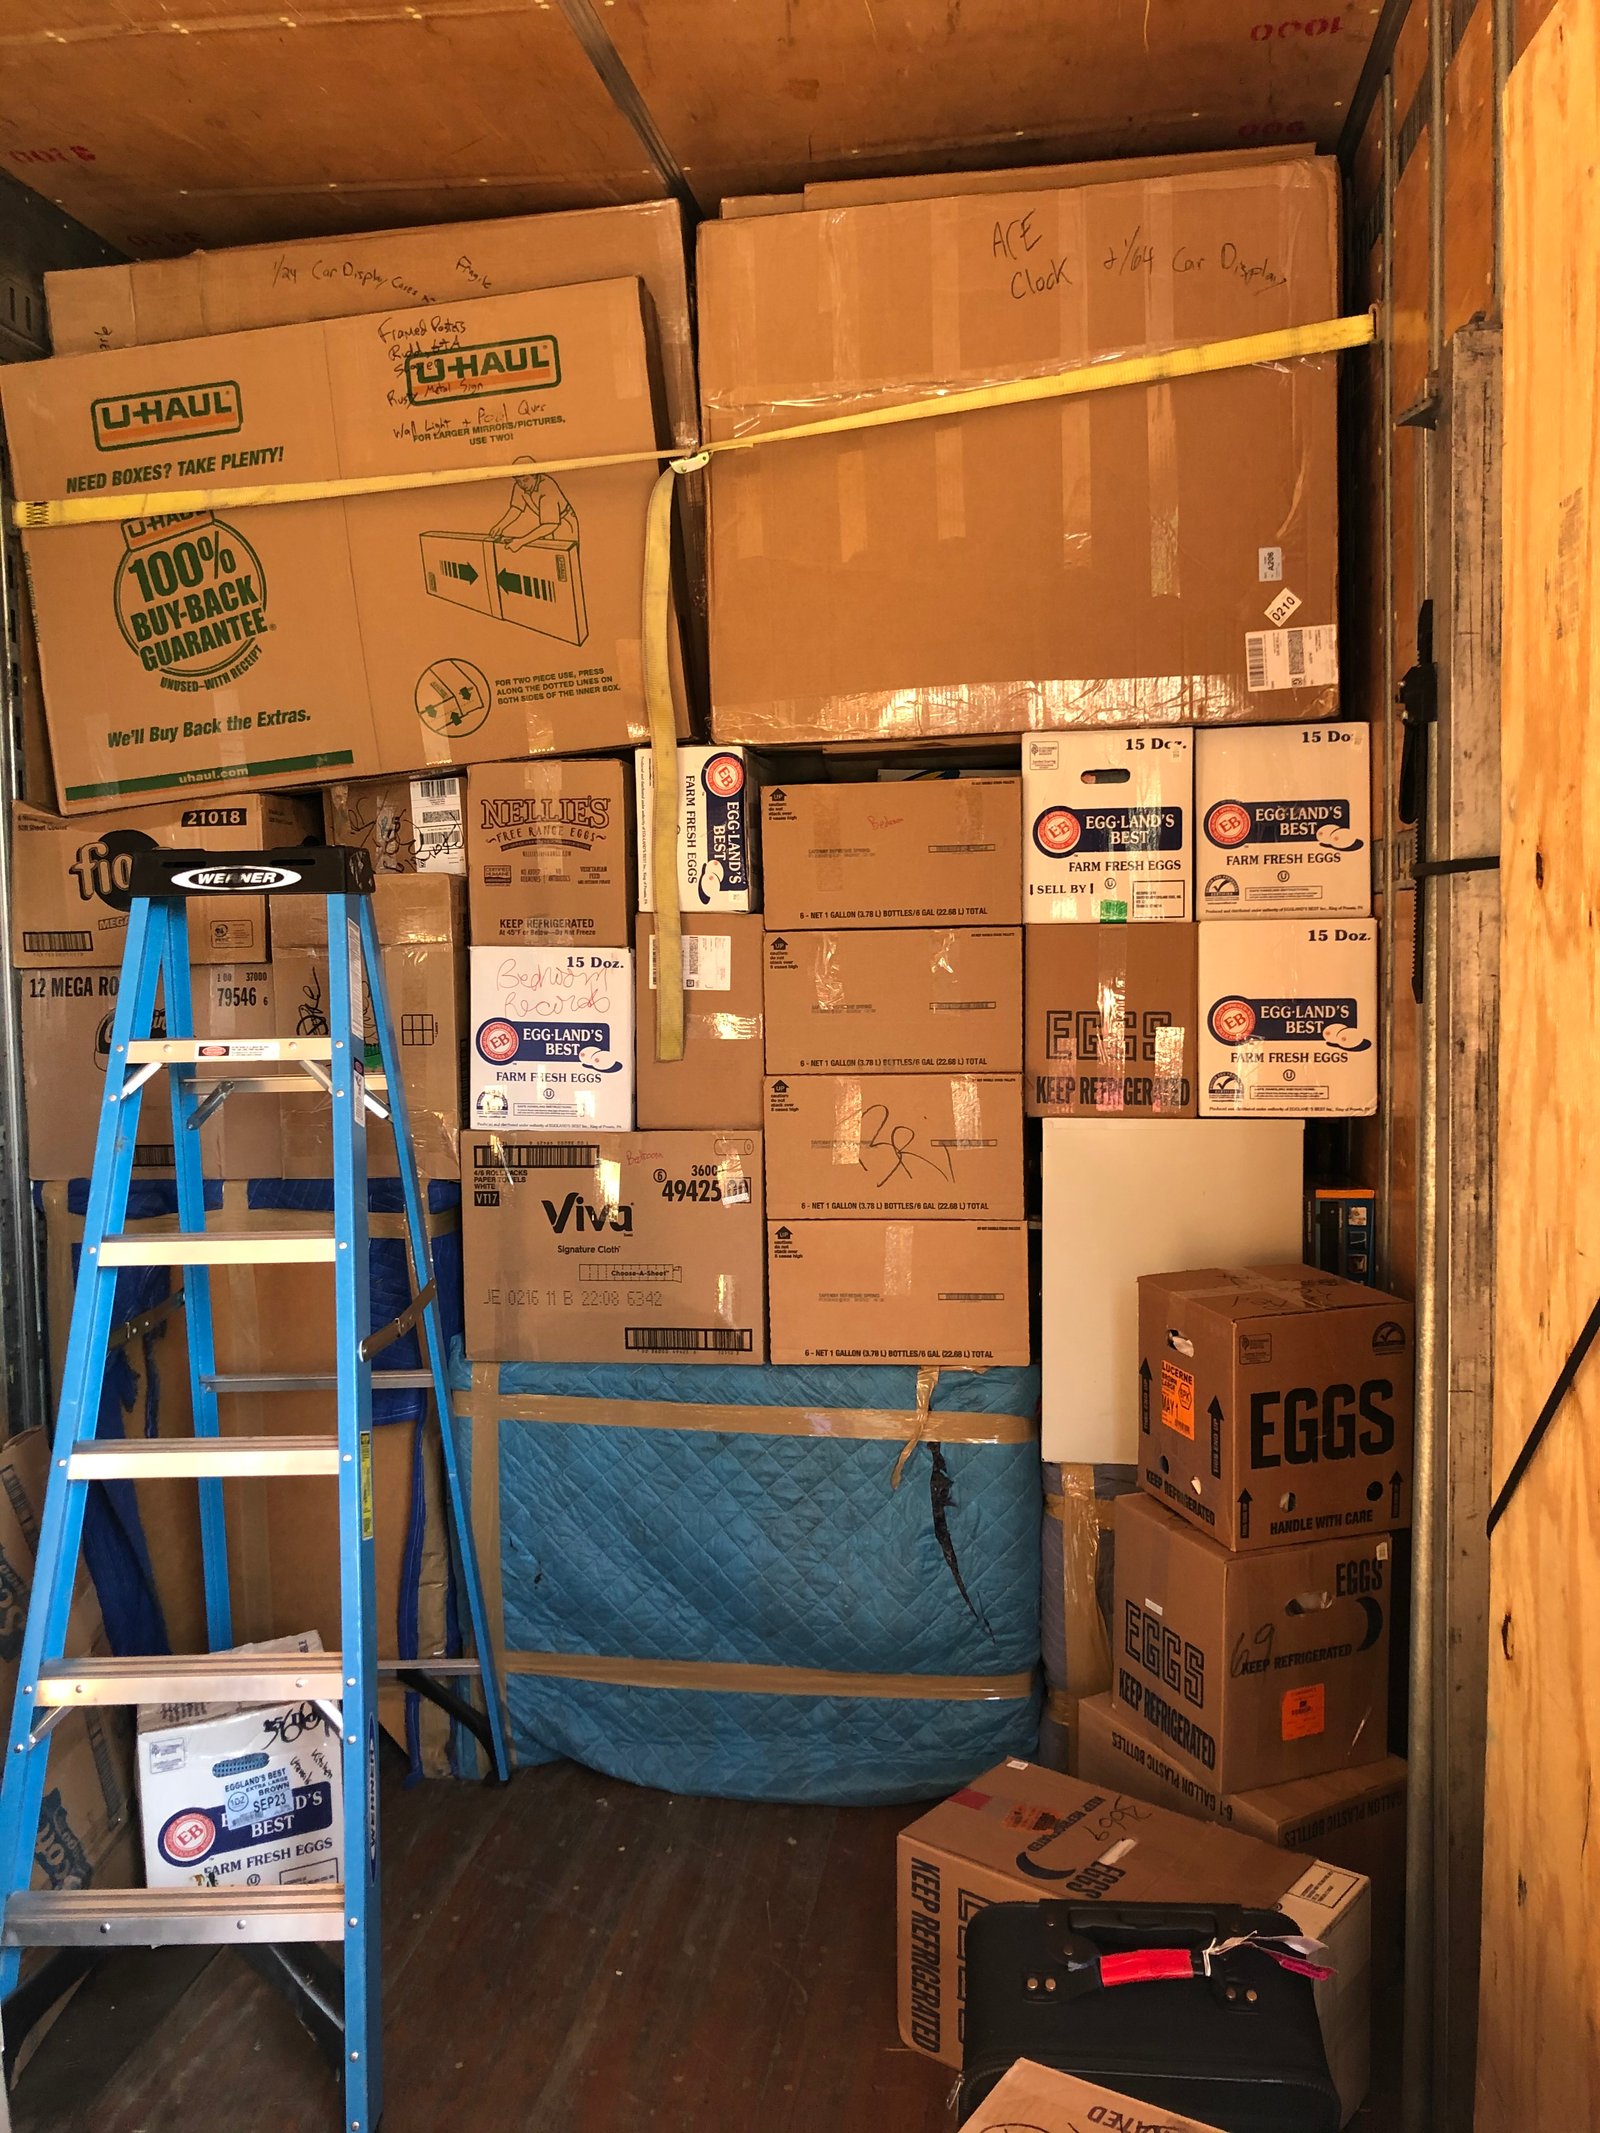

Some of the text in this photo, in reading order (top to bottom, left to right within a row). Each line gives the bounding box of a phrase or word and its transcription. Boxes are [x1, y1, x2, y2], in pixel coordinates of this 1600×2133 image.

[311, 259, 339, 279] Car
[343, 262, 388, 289] Display
[1010, 256, 1073, 300] Clock
[1171, 245, 1205, 273] Car
[1220, 242, 1287, 297] Display
[378, 316, 466, 343] Framed Posters
[416, 346, 549, 383] U-HAUL
[102, 391, 233, 430] U-HAUL
[433, 415, 566, 439] LARGER MIRRORS/PICTURES.
[469, 432, 514, 446] USE TWO!
[66, 446, 285, 494] NEED BOXES? TAKE PLENTY!
[128, 530, 237, 603] 100%
[130, 575, 259, 643] BUY-BACK
[1271, 596, 1296, 622] 0210
[139, 608, 268, 673] GUARANTEE
[230, 645, 263, 684] RECEIPT
[495, 668, 604, 687] FOR TWO PIECE USE, PRESS
[496, 676, 613, 696] ALONG THE DOTTED LINES ON
[497, 684, 621, 705] BOTH SIDES OF THE INNER BOX.
[108, 708, 311, 748] We'll Buy Back the Extras.
[1302, 731, 1321, 743] 15
[1126, 739, 1145, 750] 15
[178, 765, 249, 784] uhaul.com
[717, 766, 734, 787] EB
[187, 810, 241, 825] 21018
[481, 795, 611, 829] NELLIE'S
[496, 825, 595, 843] FREE RANGE EGGS
[686, 776, 698, 884] FARM FRESH EGGS
[1047, 820, 1070, 839] EB
[1219, 816, 1241, 833] EB
[1280, 822, 1318, 836] BEST
[713, 825, 727, 861] BEST
[1110, 831, 1150, 845] BEST
[1069, 860, 1182, 872] FARM FRESH EGGS
[1226, 853, 1341, 865] FARM FRESH EGGS
[198, 872, 277, 884] WERNER
[1037, 884, 1086, 894] SELL BY
[500, 918, 594, 929] KEEP REFRIGERATED
[1308, 930, 1371, 942] 15 Doz.
[566, 957, 624, 969] 15 Doz.
[30, 977, 94, 998] 12 MEGA
[245, 972, 268, 982] 37000
[217, 988, 257, 1007] 79546
[1224, 1013, 1246, 1030] EB
[1285, 1021, 1324, 1034] BEST
[489, 1034, 510, 1050] EB
[545, 1043, 580, 1056] BEST
[1230, 1052, 1348, 1063] FARM FRESH EGGS
[496, 1072, 602, 1083] FARM EGGS
[1036, 1076, 1076, 1104] KEEP
[476, 1193, 498, 1204] VT17
[662, 1180, 722, 1202] 49425
[542, 1192, 633, 1234] Viva
[812, 1202, 989, 1210] NET GALLON (3.78 BOTTLES/6 GAL TOTAL
[557, 1245, 620, 1255] Signature Cloth
[484, 1289, 620, 1306] JE 22:08
[1162, 1360, 1193, 1386] LUCERNE
[1162, 1394, 1175, 1413] MAY
[1250, 1378, 1394, 1469] EGGS
[1146, 1469, 1215, 1526] KEEP REFRIGERATED
[1270, 1509, 1373, 1535] HANDLE WITH CARE
[1336, 1559, 1383, 1597] EGGS
[1126, 1600, 1204, 1709] EGGS
[1241, 1644, 1352, 1675] KEEP REFRIGERATED
[1120, 1668, 1142, 1711] KEEP
[1144, 1688, 1215, 1771] REFRIGERATED
[225, 1768, 286, 1792] EGGLAND'S BEST
[246, 1776, 288, 1793] EXTRA LARGE
[1112, 1732, 1233, 1822] 6-1 GALLON PLASTIC BOTTLES
[258, 1782, 290, 1796] BROWN
[253, 1792, 287, 1813] SEP23
[177, 1824, 204, 1847] EB
[252, 1814, 295, 1838] BEST
[1285, 1804, 1365, 1848] PLASTIC BOTTLES
[204, 1837, 333, 1879] FARM FRESH EGGS
[1065, 1861, 1126, 1899] EGGS
[911, 1857, 941, 2053] KEEP REFRIGERATED
